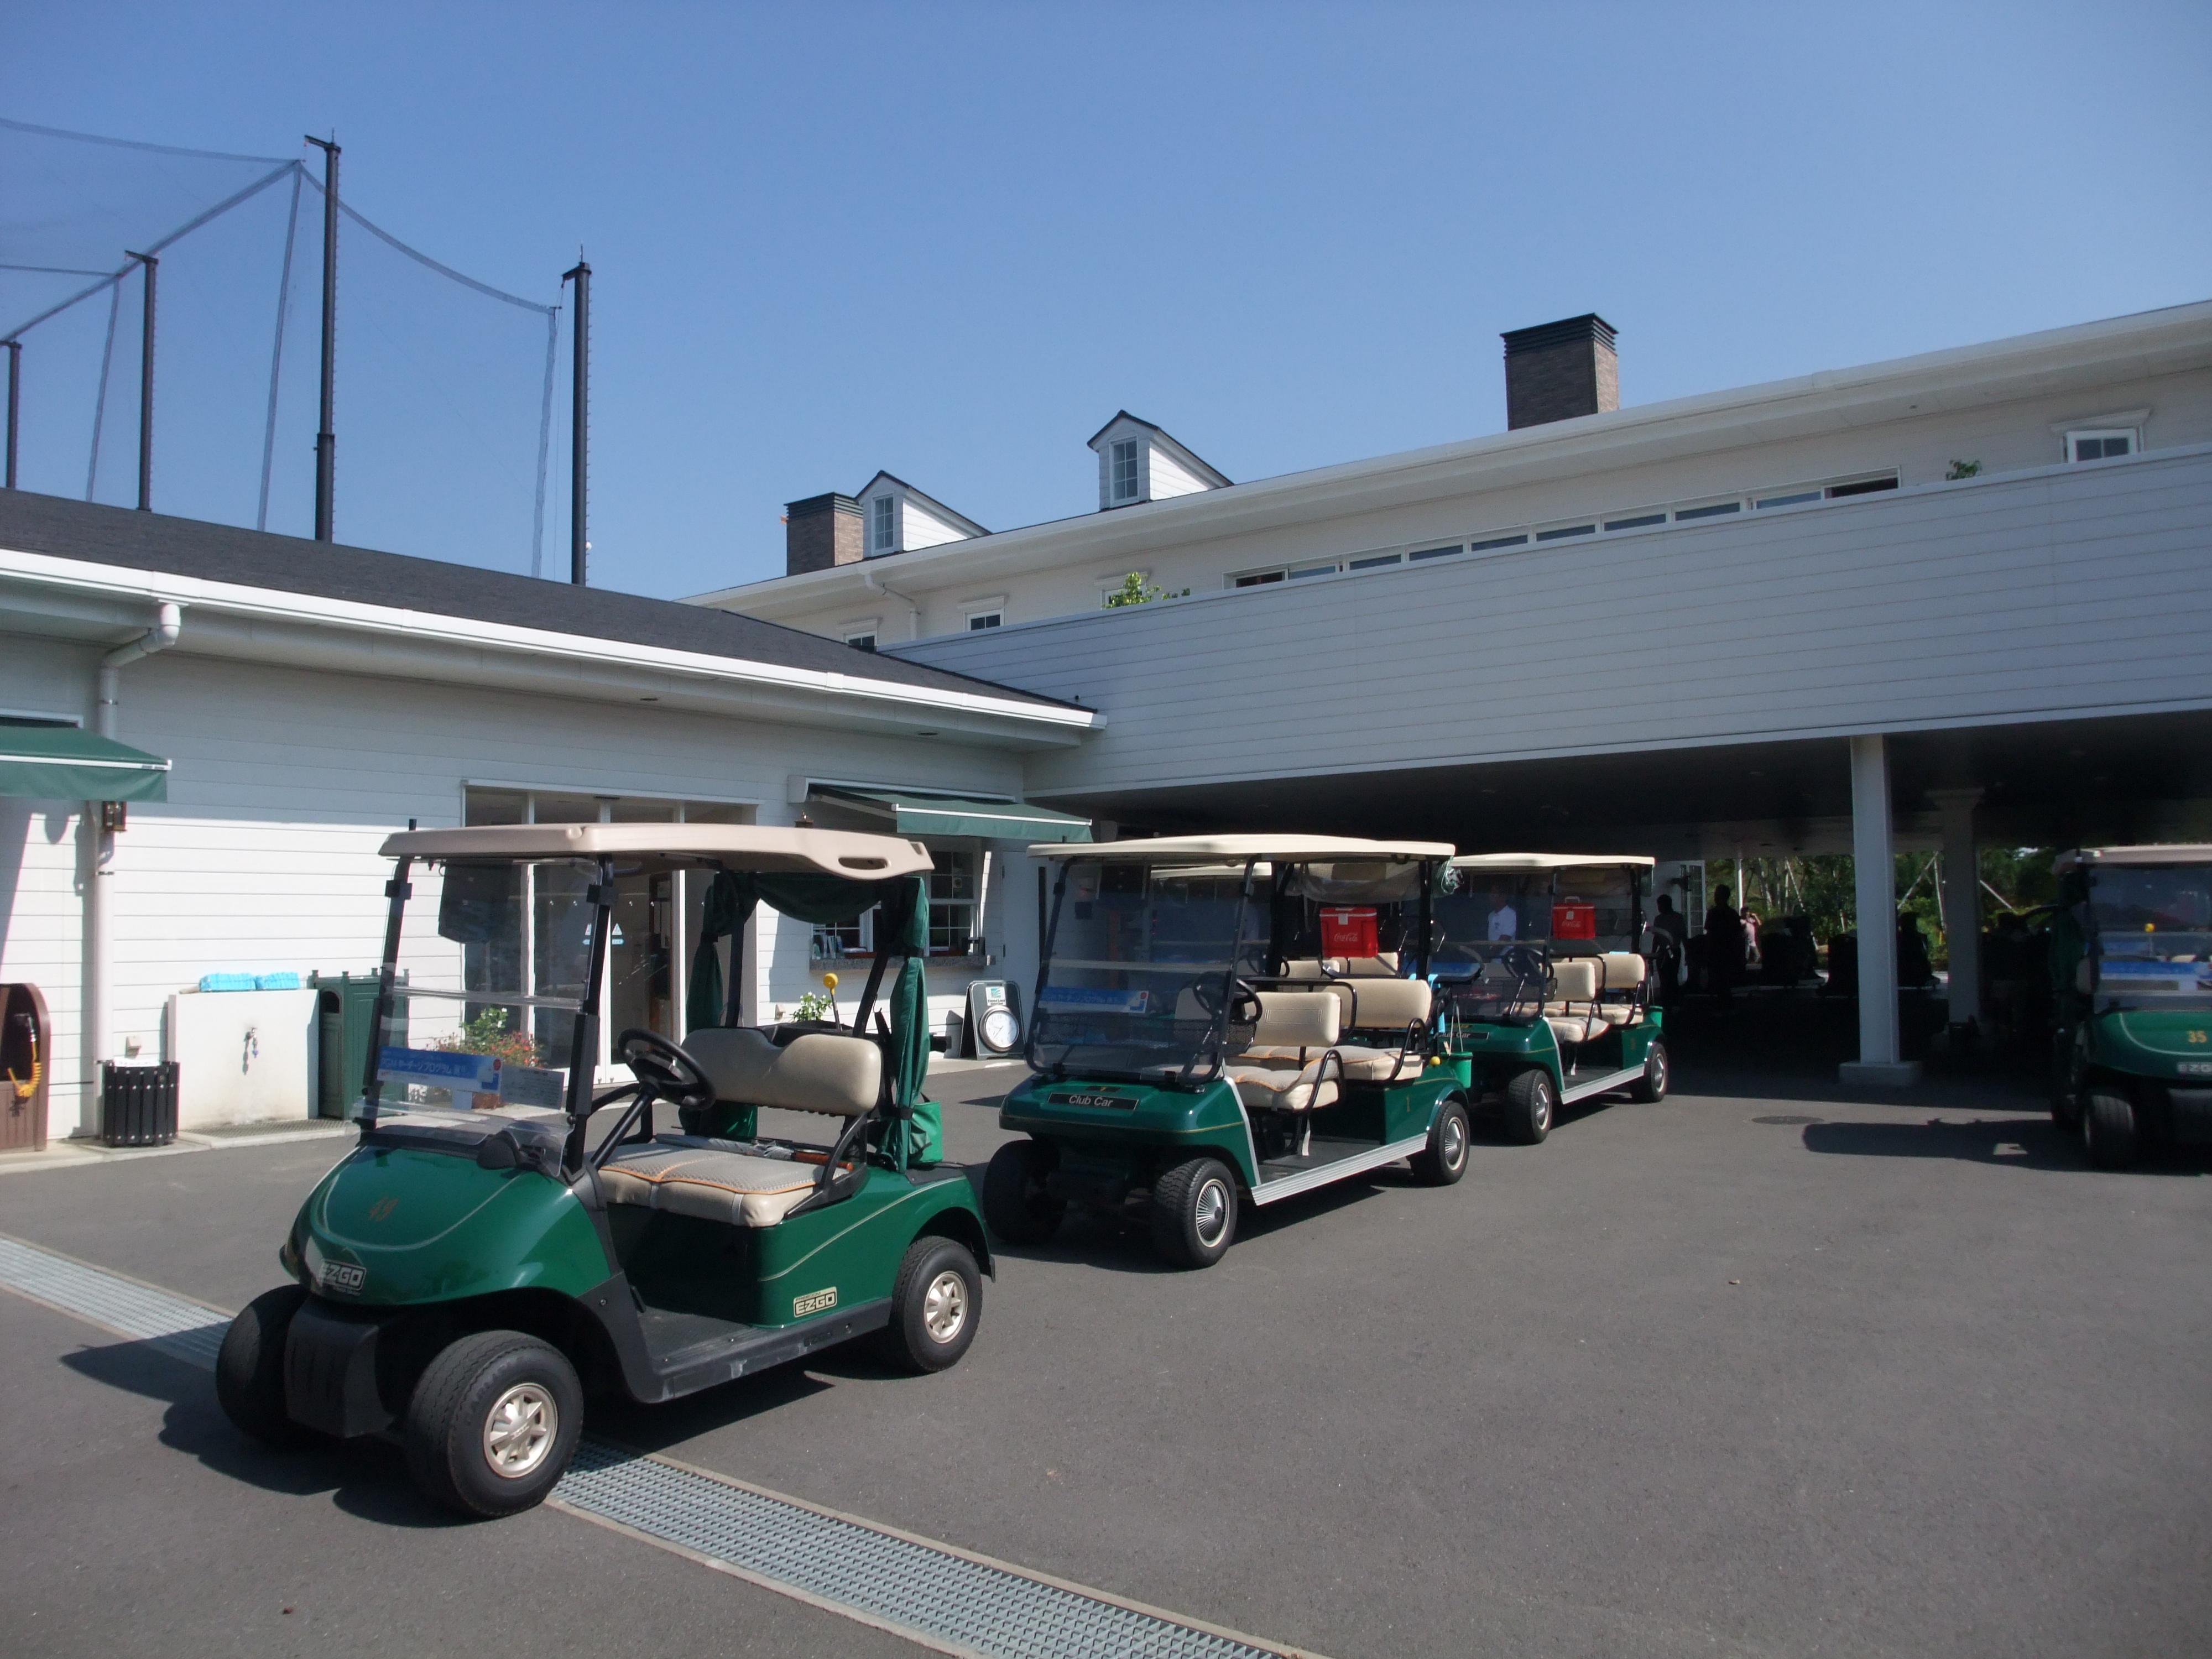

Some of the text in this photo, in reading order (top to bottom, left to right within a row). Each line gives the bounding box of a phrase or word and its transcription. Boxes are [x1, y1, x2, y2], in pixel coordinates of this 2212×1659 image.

[2187, 1031, 2208, 1043] 35
[1068, 1095, 1114, 1107] Club Car
